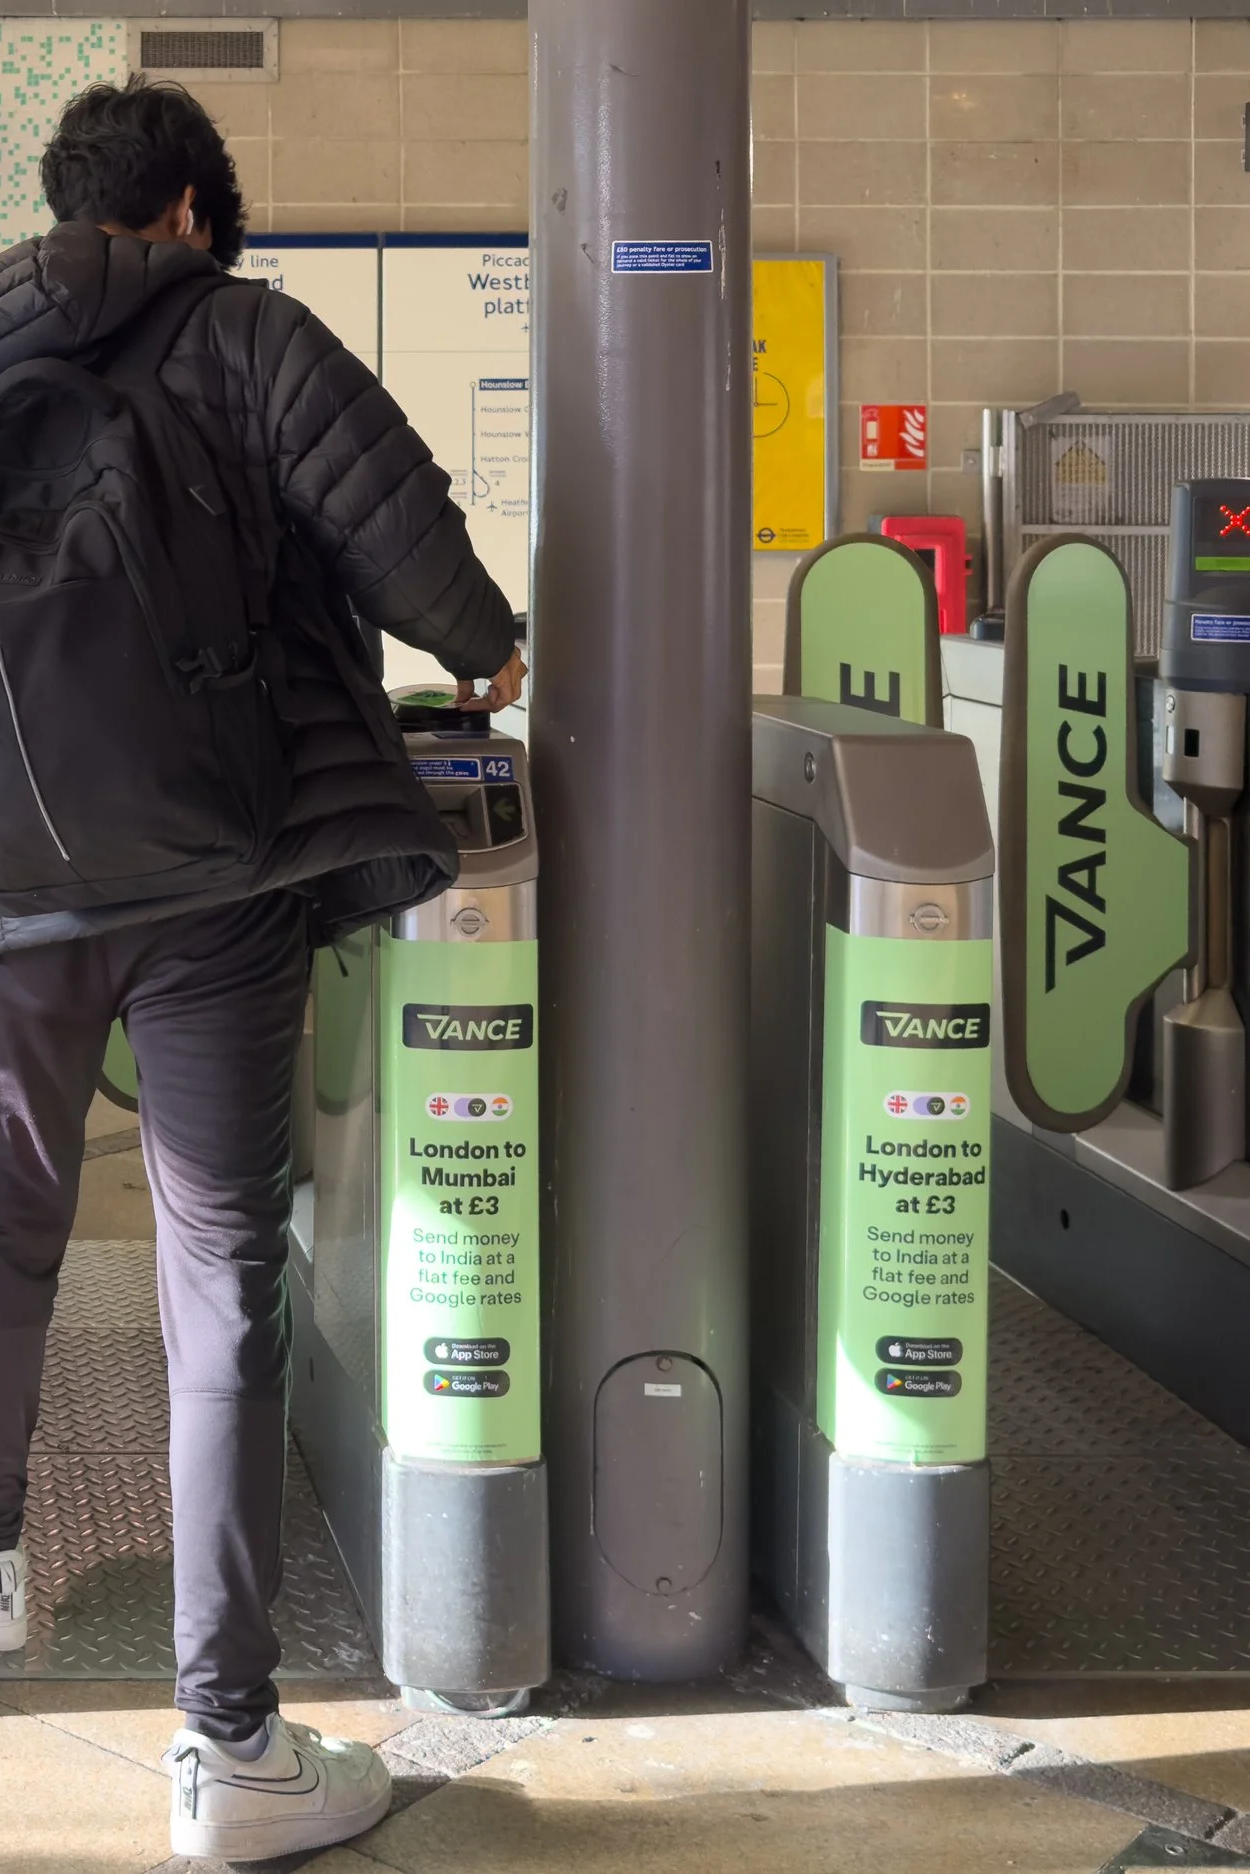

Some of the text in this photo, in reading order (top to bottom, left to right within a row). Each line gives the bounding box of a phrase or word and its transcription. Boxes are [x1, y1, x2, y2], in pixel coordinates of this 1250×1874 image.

[629, 246, 652, 254] penalty
[251, 255, 278, 267] line
[480, 380, 524, 389] Hounslow
[480, 430, 521, 438] Hounslow
[485, 760, 510, 777] 42
[1045, 664, 1108, 994] VANCE
[417, 1013, 522, 1041] VANCE
[876, 1011, 981, 1039] VANCE
[409, 1137, 527, 1159] London to
[866, 1135, 982, 1159] London to
[421, 1166, 516, 1187] Mumbai
[858, 1162, 986, 1188] Hyderabad
[439, 1196, 499, 1215] at £3
[895, 1195, 956, 1215] at £3
[413, 1228, 520, 1247] Send money
[867, 1226, 974, 1248] Send money
[419, 1250, 515, 1266] to India at a
[872, 1248, 970, 1265] to India at a
[419, 1269, 515, 1286] flat fee and
[871, 1267, 969, 1285] flat fee and
[409, 1287, 522, 1308] Google rates
[862, 1285, 975, 1308] Google rates
[451, 1349, 499, 1361] App Store
[905, 1349, 952, 1360] App Store
[451, 1381, 499, 1393] Google Play
[905, 1381, 951, 1393] Google Play
